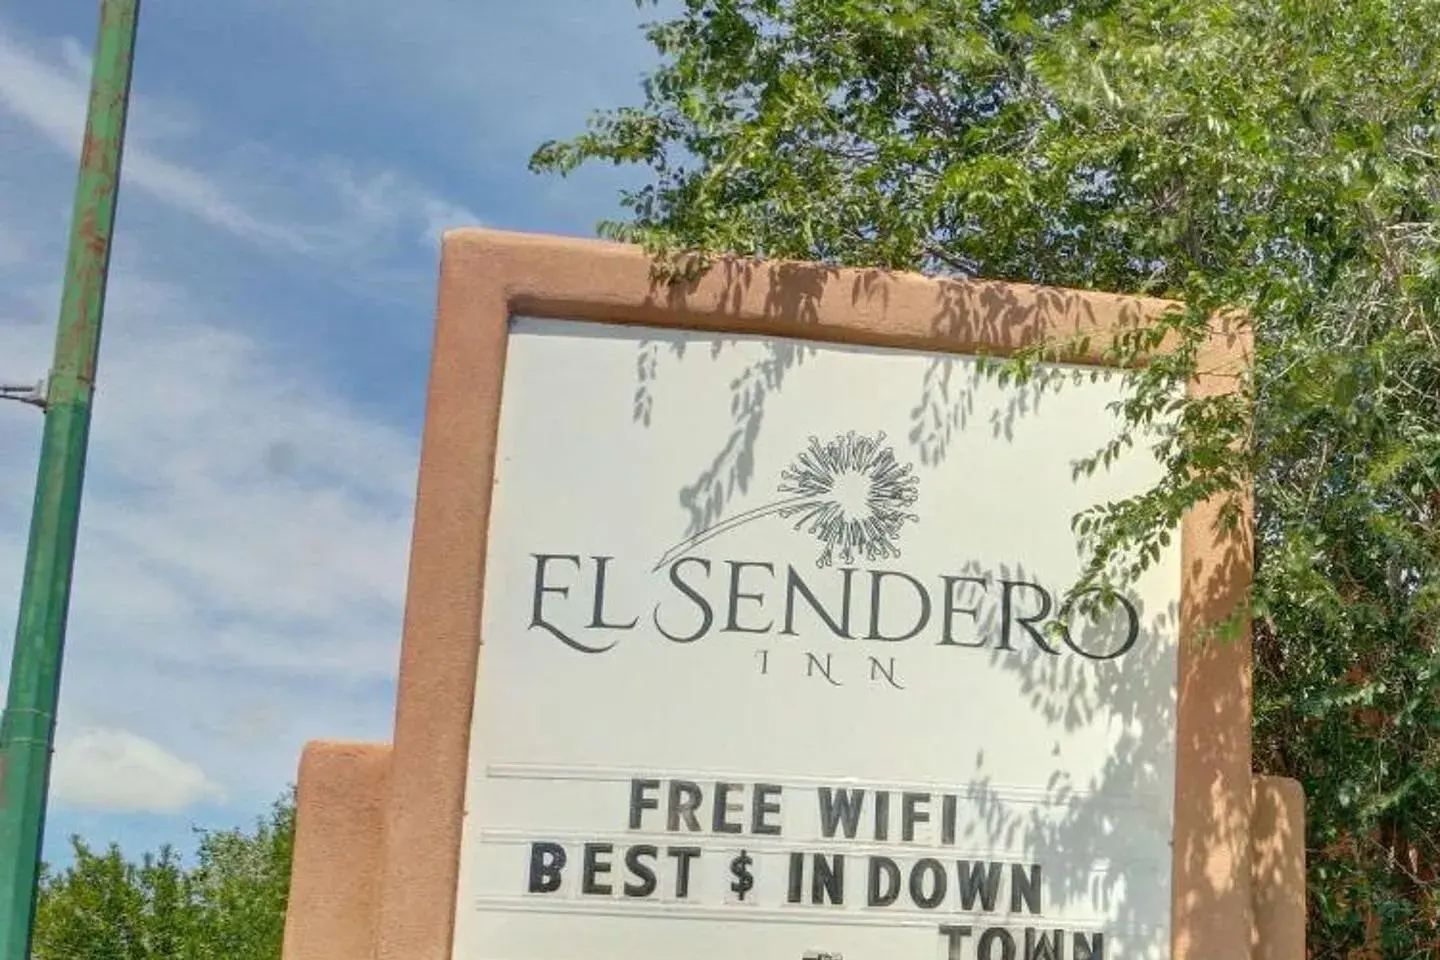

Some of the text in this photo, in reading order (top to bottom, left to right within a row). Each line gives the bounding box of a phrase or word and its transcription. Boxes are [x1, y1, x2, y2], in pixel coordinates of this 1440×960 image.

[528, 553, 1139, 660] EL SENDERO
[755, 648, 904, 689] INN
[629, 778, 957, 845] FREE WIFI
[528, 842, 1041, 914] BEST $ IN DOWN
